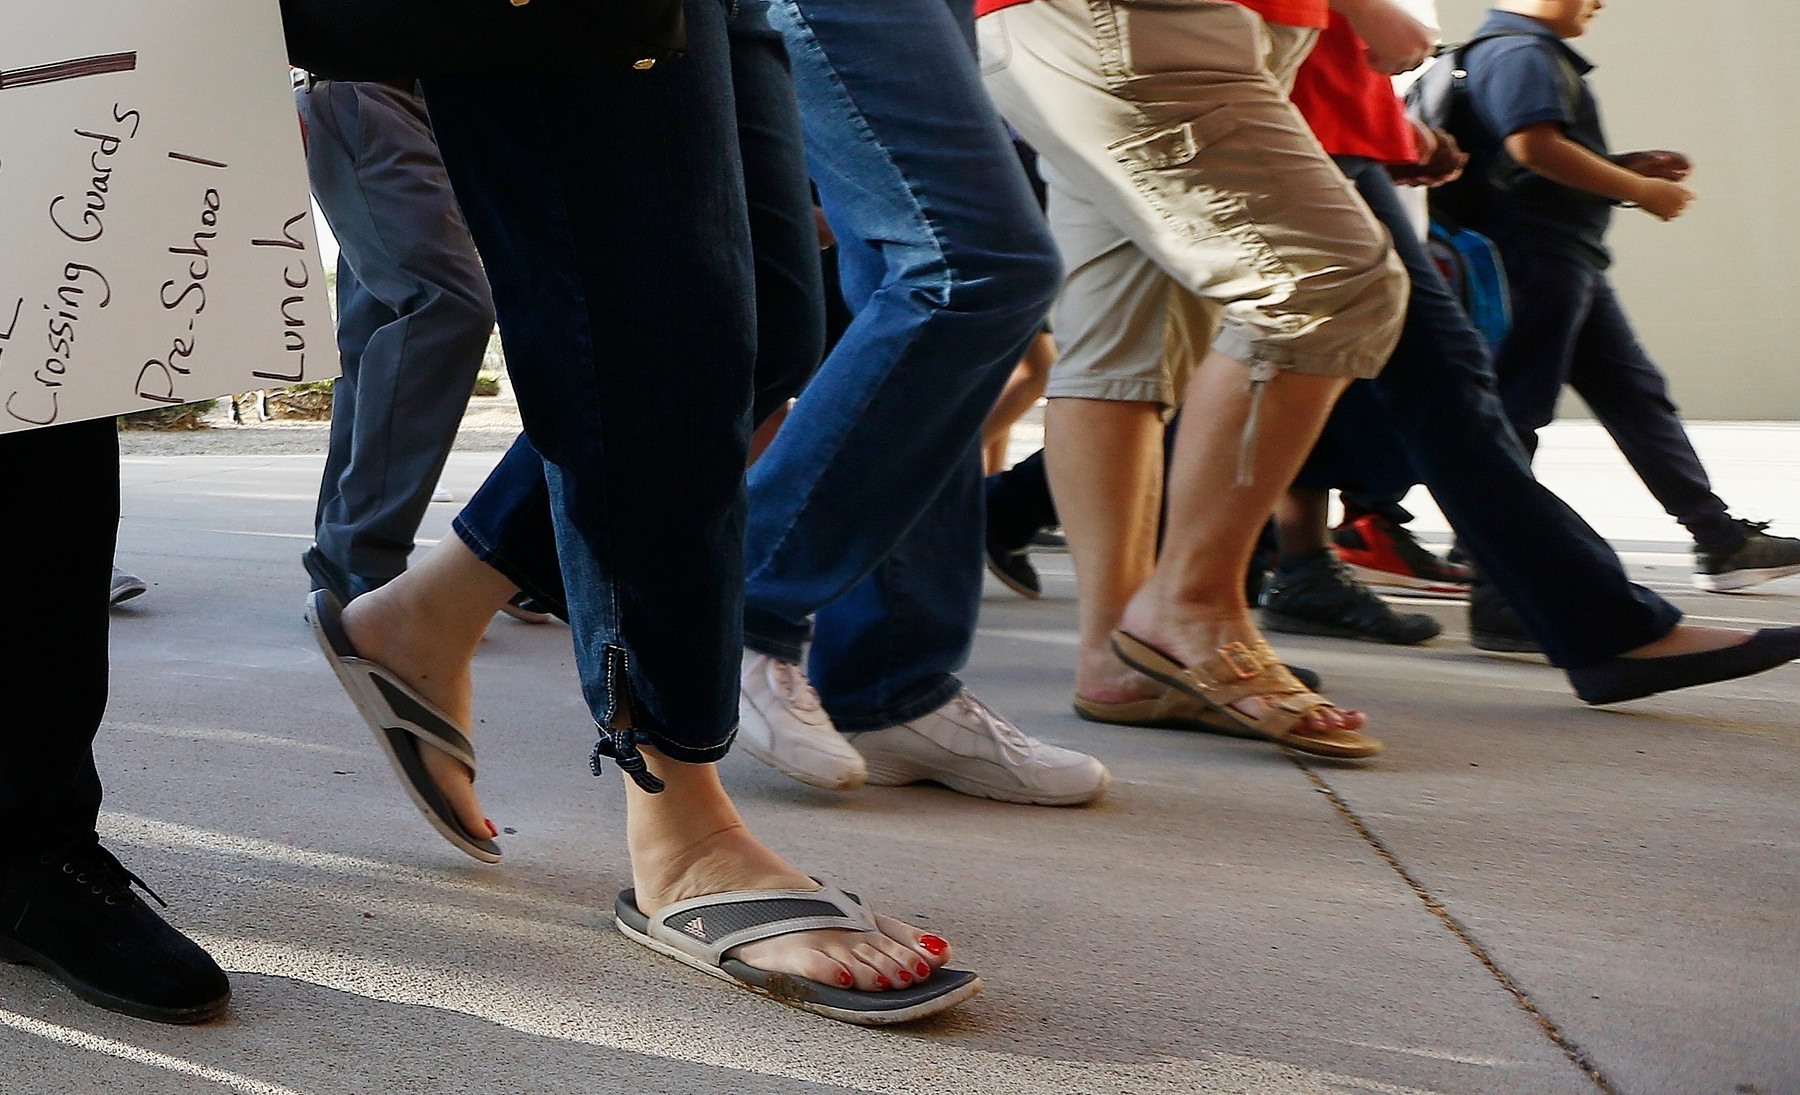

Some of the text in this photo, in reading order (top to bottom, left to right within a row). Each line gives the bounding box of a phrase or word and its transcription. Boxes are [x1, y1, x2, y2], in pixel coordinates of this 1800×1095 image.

[6, 102, 141, 426] Crossing Guards
[250, 210, 310, 383] Lunch
